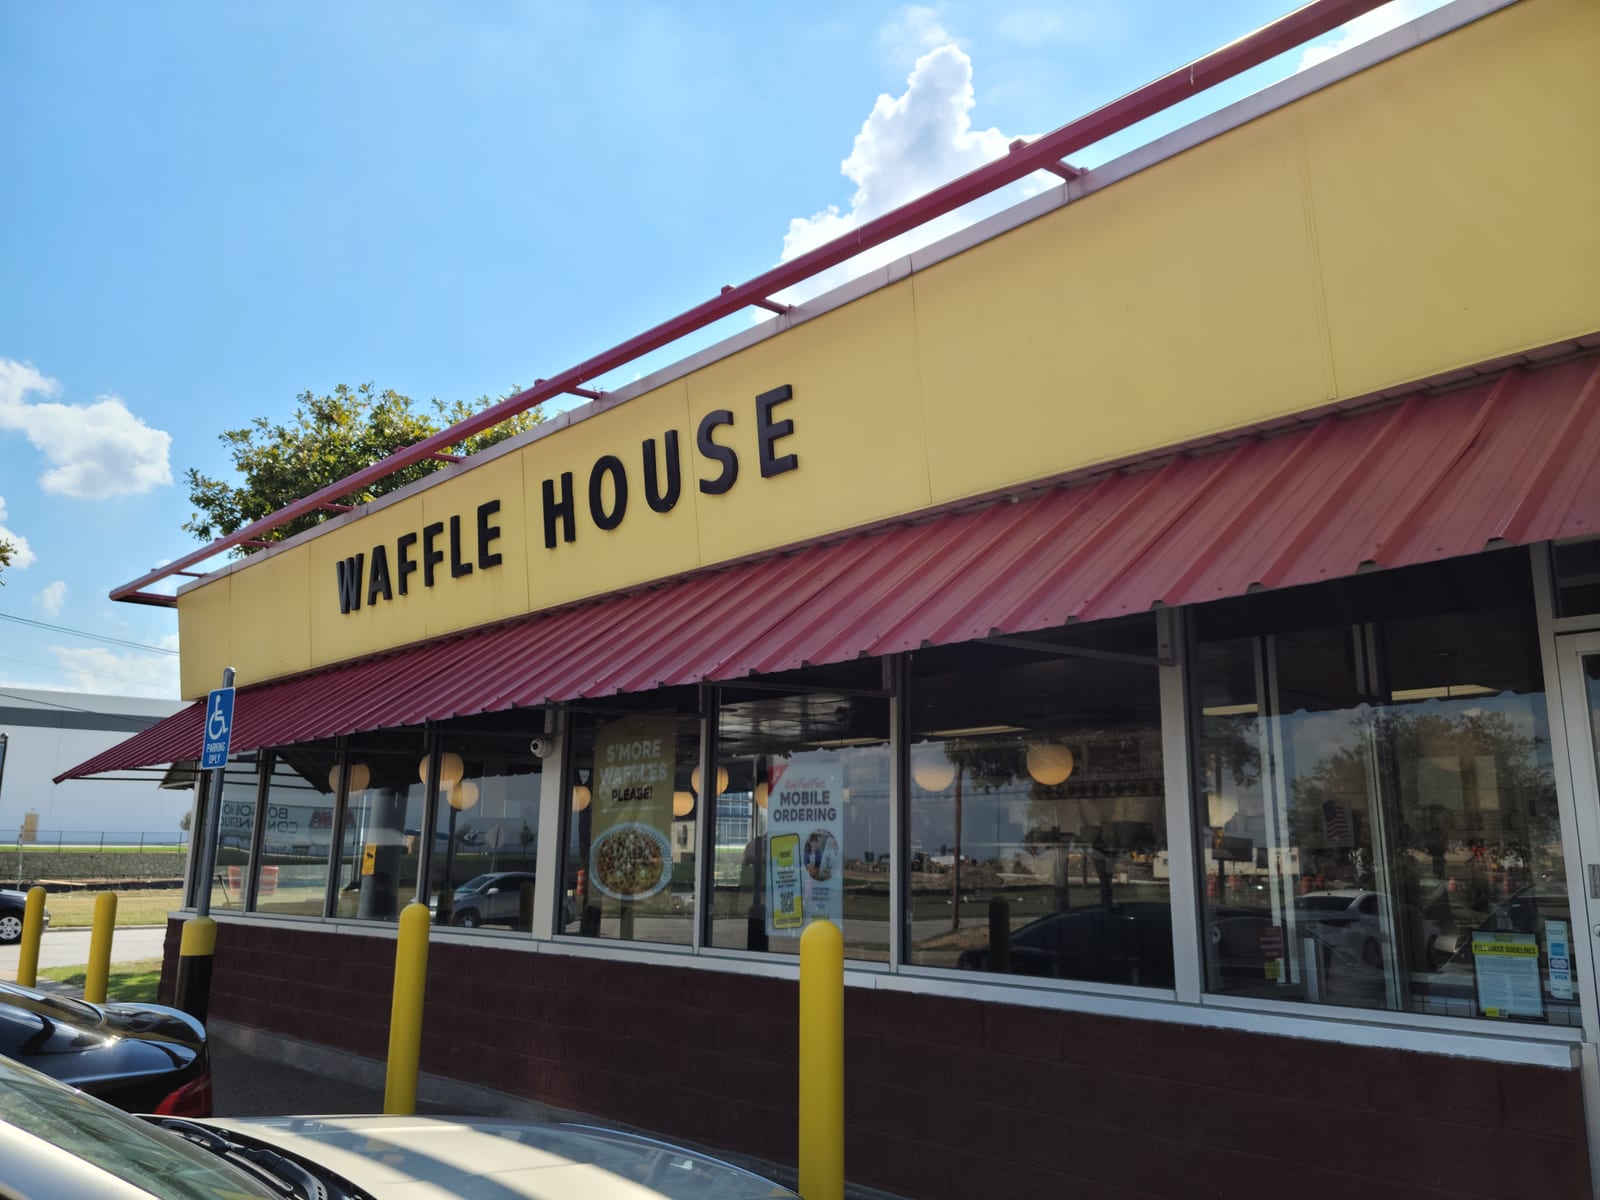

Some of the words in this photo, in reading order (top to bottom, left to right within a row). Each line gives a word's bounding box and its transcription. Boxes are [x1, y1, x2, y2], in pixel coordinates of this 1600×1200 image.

[336, 500, 502, 614] WAFFLE
[542, 384, 798, 549] HOUSE
[206, 741, 226, 753] PARKING
[607, 739, 662, 763] S'MORE
[208, 753, 222, 765] ONLY
[612, 786, 653, 801] PLEASE!
[780, 790, 831, 807] MOBILE
[773, 807, 837, 822] ORDERING
